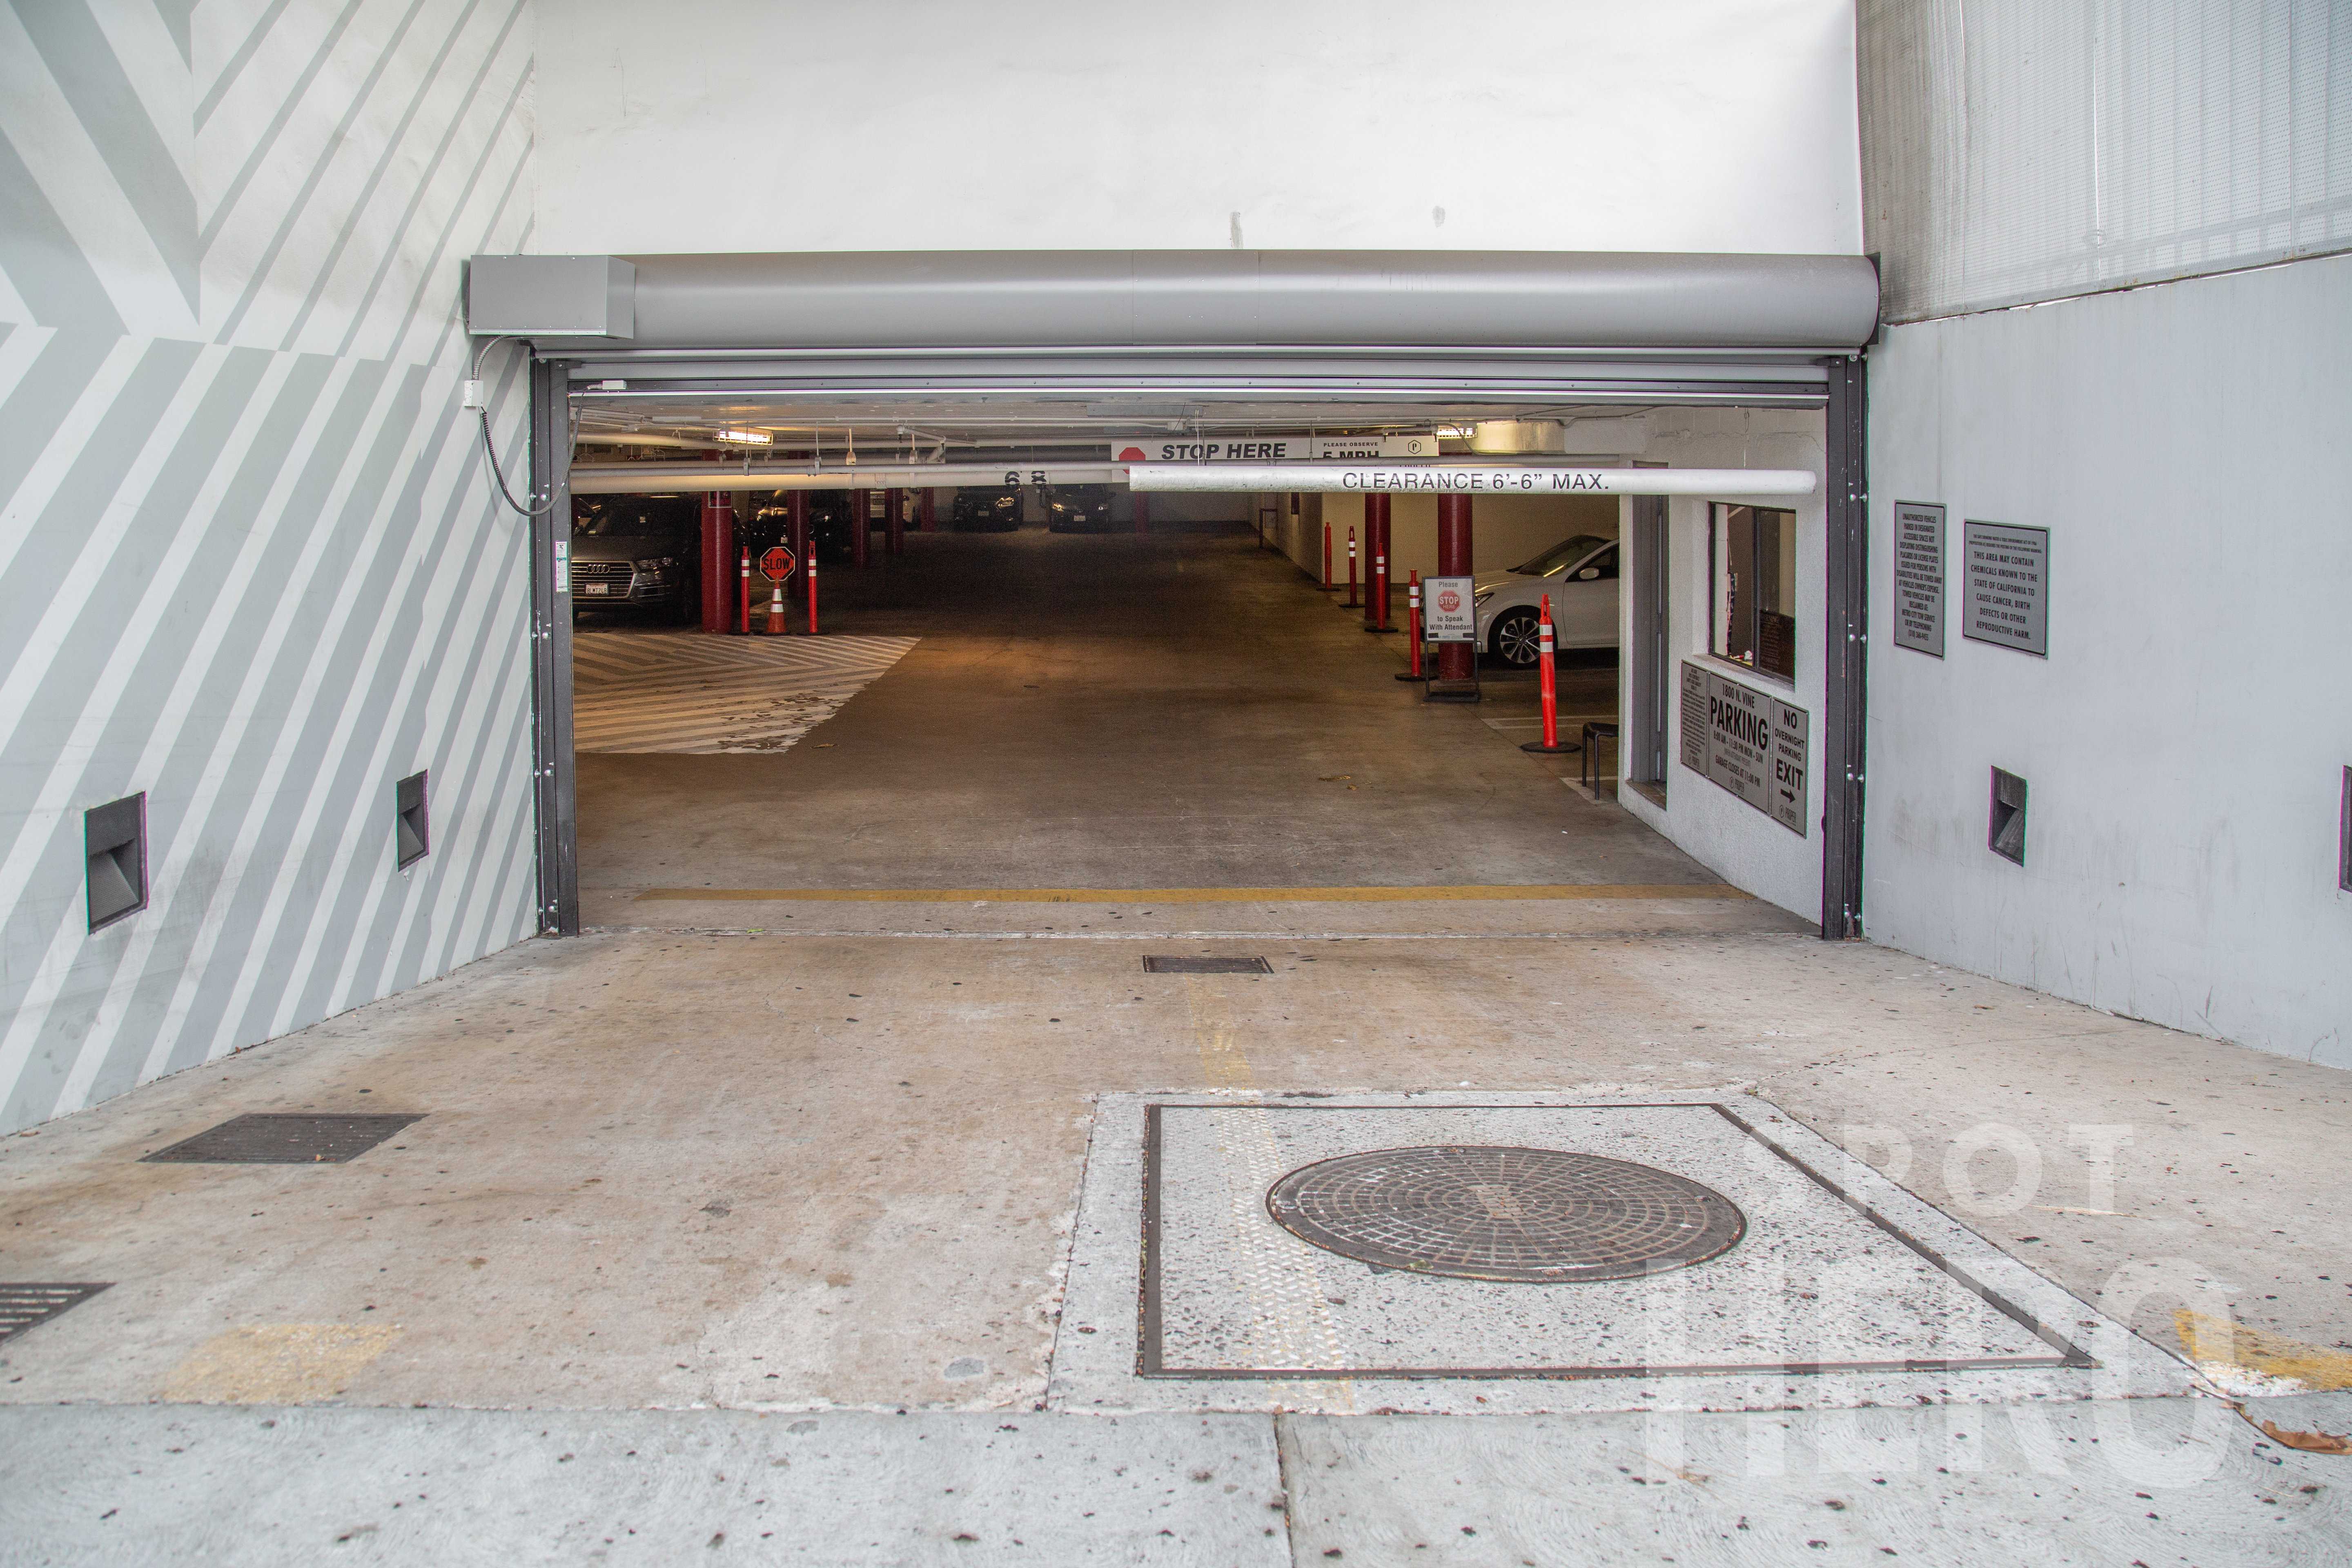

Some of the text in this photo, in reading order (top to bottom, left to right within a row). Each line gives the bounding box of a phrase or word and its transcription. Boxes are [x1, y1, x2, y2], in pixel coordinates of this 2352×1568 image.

[1161, 443, 1286, 459] STOP HERE
[1343, 472, 1483, 489] CLEARANCE
[1553, 473, 1609, 490] MAX.
[1903, 532, 1918, 541] ACCESSIBLE
[1918, 524, 1935, 533] DESIGNATED
[1900, 541, 1915, 550] DISPLAYING
[762, 558, 791, 570] SLOW
[1900, 551, 1913, 559] PLACARDS
[1918, 553, 1929, 562] LICENSE
[1974, 551, 2034, 567] THIS AREA MAY CONTAIN
[1916, 563, 1928, 572] PERSONS
[1971, 564, 2038, 582] CHEMICALS KNOWN TO THE
[1924, 574, 1933, 582] TOWED
[1934, 576, 1942, 584] AWAY
[1902, 590, 1912, 598] TOWED
[1912, 591, 1924, 600] VEHICLES
[1974, 579, 2035, 596] STATE OF CALIFORNIA TO
[1909, 601, 1924, 610] RECLAIMED
[1976, 593, 2030, 610] CAUSE CANCER, BIRTH
[1924, 614, 1935, 623] SERVICE
[1980, 608, 2026, 624] DEFECTS OR OTHER
[1976, 620, 2031, 640] REPRODUCTIVE HARM.
[1722, 684, 1755, 708] 1800 N. VINE
[1711, 696, 1768, 750] PARKING
[1784, 709, 1797, 729] NO
[1721, 733, 1726, 745] AM
[1738, 743, 1744, 754] PM
[1744, 746, 1753, 758] MON
[1775, 728, 1804, 749] OVERNIGHT
[1779, 743, 1801, 762] PARKING
[1715, 755, 1728, 769] GARAGE
[1728, 762, 1740, 776] CLOSES
[1740, 768, 1744, 778] AT
[1755, 776, 1760, 787] PM
[1776, 758, 1803, 791] EXIT
